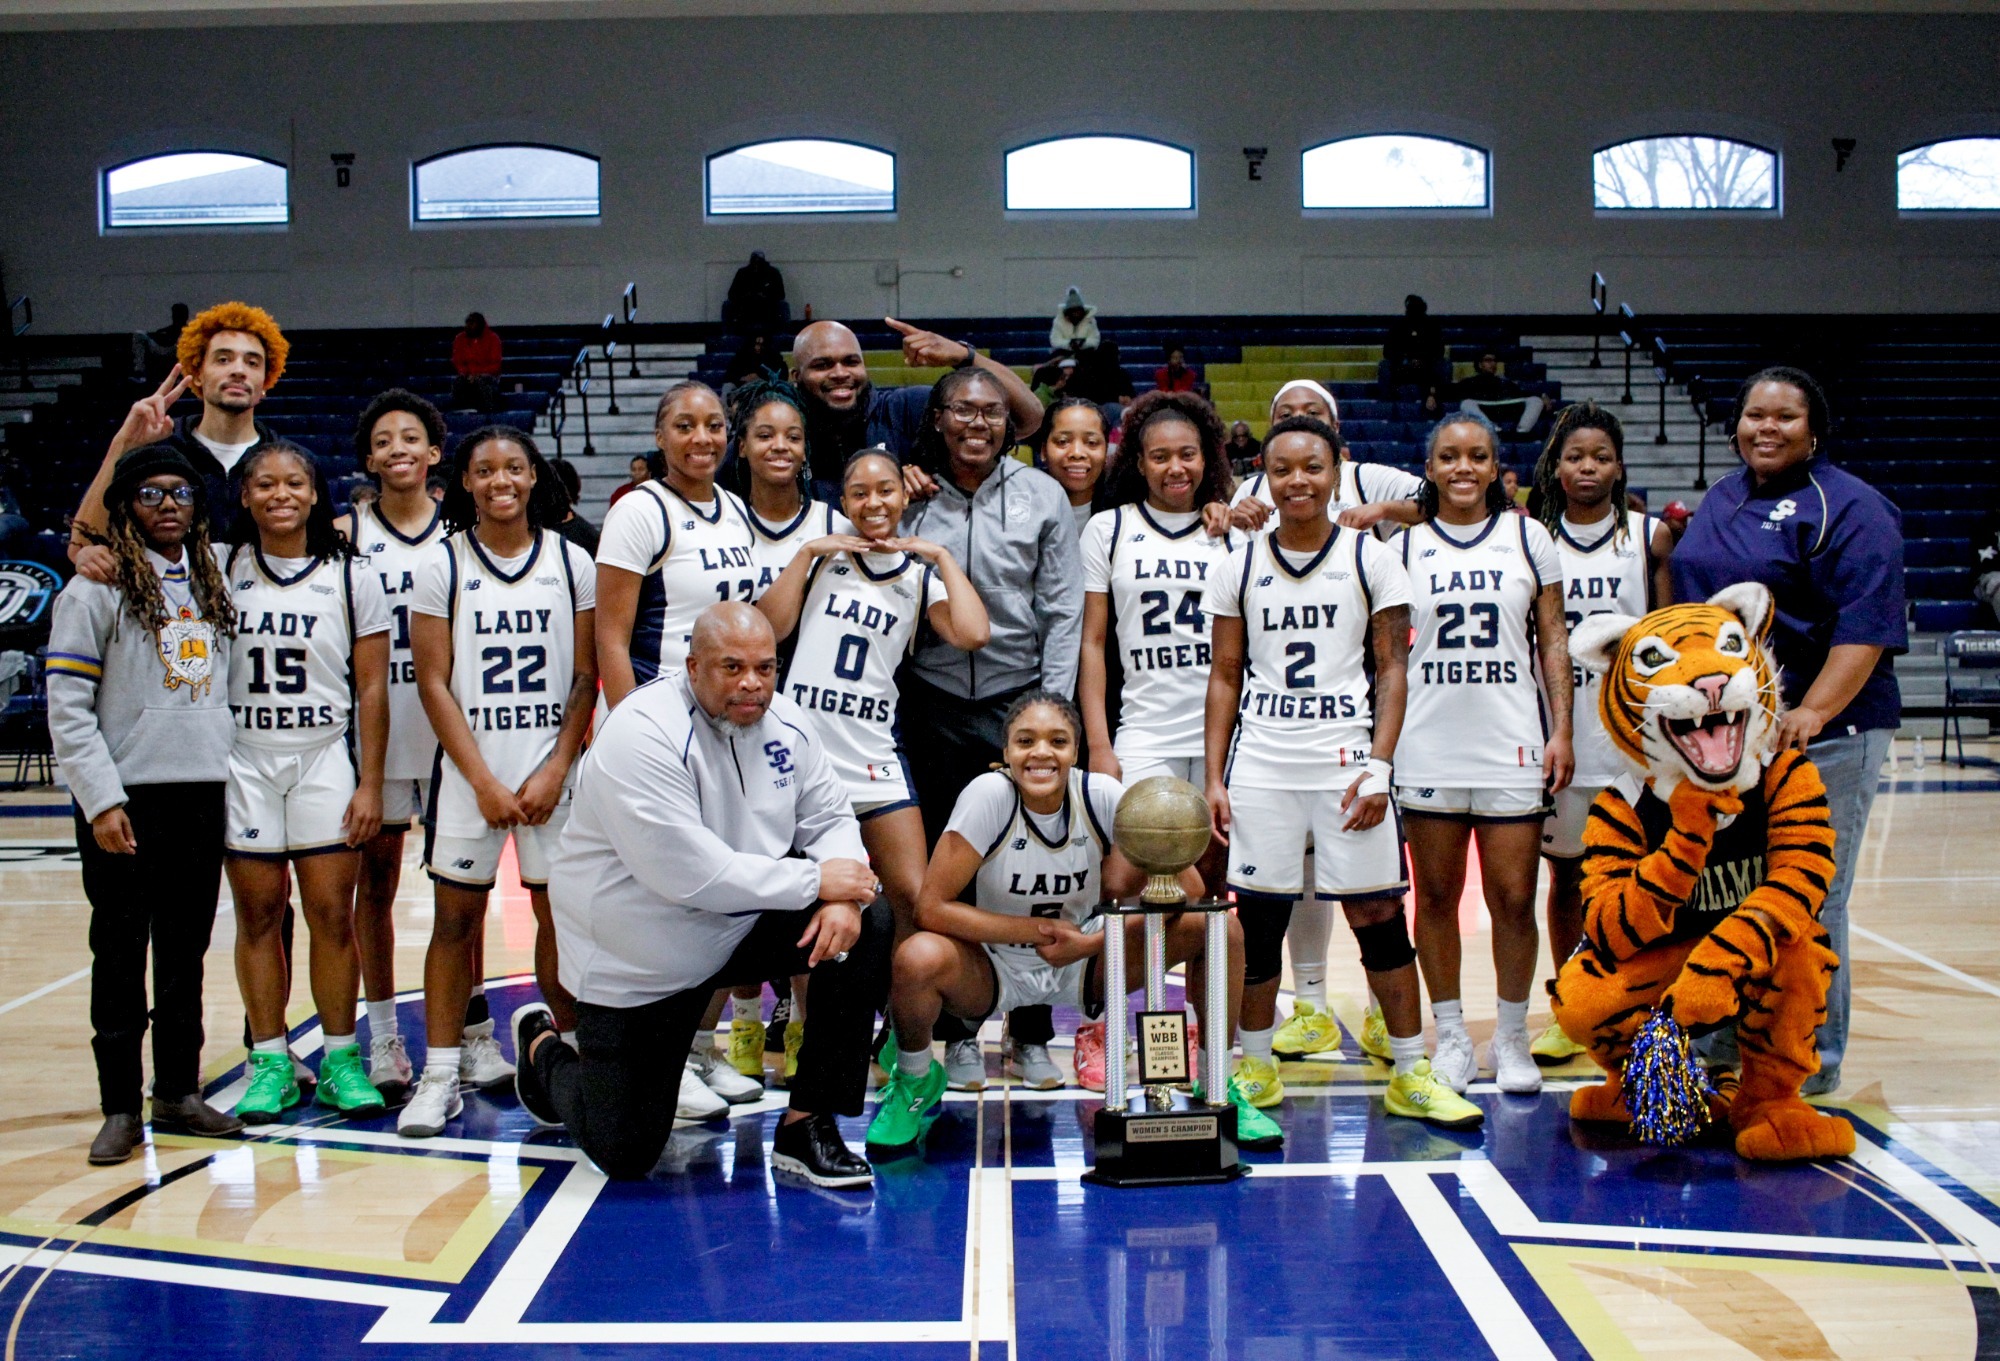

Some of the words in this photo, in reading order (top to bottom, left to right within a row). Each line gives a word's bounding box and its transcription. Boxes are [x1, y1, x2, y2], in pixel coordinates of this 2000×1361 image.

[1249, 161, 1262, 180] E
[379, 571, 414, 594] LA
[1135, 559, 1208, 580] LADY
[1430, 570, 1503, 595] LADY
[1568, 577, 1622, 599] ADY
[239, 611, 318, 638] LADY
[475, 609, 551, 634] LADY
[825, 593, 898, 636] LADY
[1140, 590, 1205, 636] 24
[1262, 605, 1338, 631] LADY
[1436, 602, 1499, 649] 23
[392, 605, 411, 649] 1
[482, 645, 547, 694] 22
[834, 633, 869, 681] 0
[1130, 643, 1211, 671] TIGER
[1285, 642, 1316, 689] 2
[248, 647, 307, 694] 15
[1421, 661, 1517, 684] TIGERS
[792, 683, 889, 723] TIGERS
[1256, 693, 1356, 719] TIGERS
[229, 705, 334, 729] TIGERS
[469, 703, 562, 731] TIGERS
[1353, 750, 1365, 762] M
[882, 766, 890, 777] S
[1009, 868, 1089, 896] LADY
[1151, 1032, 1178, 1043] WBB
[1171, 1124, 1212, 1133] CHAMPION
